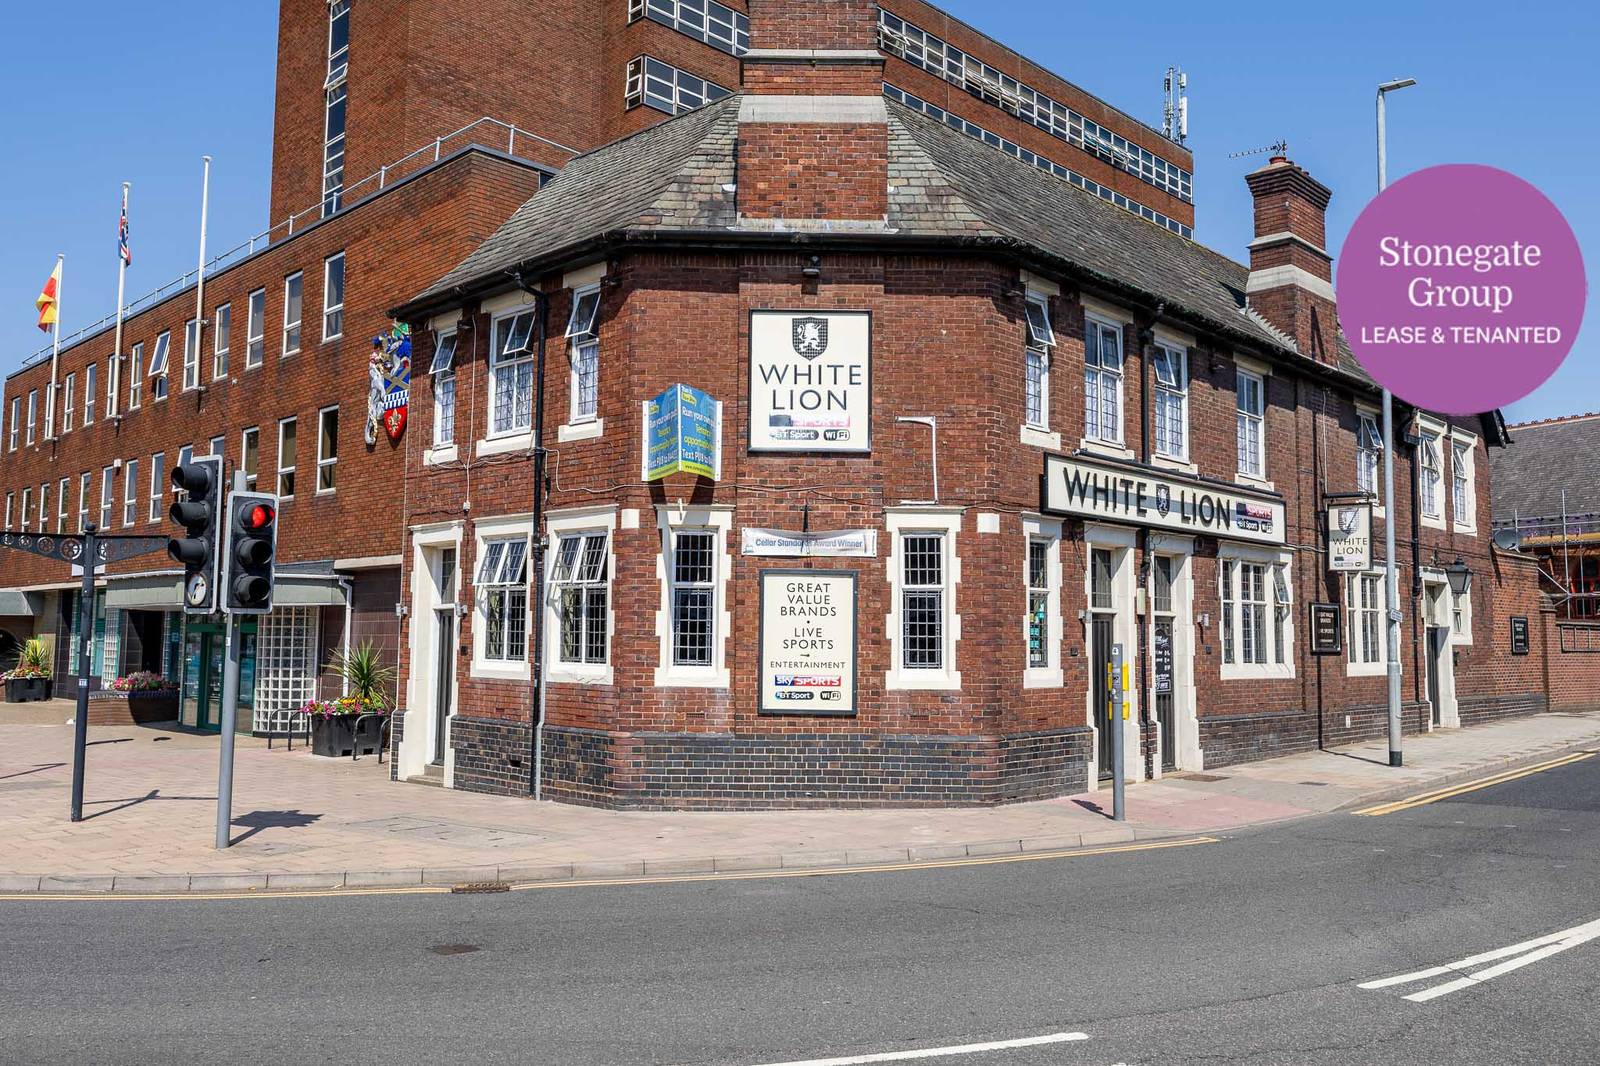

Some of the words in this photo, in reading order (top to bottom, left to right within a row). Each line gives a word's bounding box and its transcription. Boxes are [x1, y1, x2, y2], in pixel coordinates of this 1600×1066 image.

[758, 364, 862, 385] WHITE
[772, 389, 847, 411] LION
[790, 431, 815, 439] Sport
[1063, 467, 1147, 516] WHITE
[1180, 490, 1231, 529] LION
[755, 539, 776, 547] Cellar
[838, 540, 862, 548] Winner
[1332, 537, 1368, 545] WHITE
[1336, 546, 1363, 554] LION
[786, 582, 831, 593] GREAT
[787, 594, 831, 605] VALUE
[780, 606, 837, 616] BRANDS
[794, 627, 823, 638] LIVE
[783, 639, 834, 650] SPORTS
[770, 661, 847, 669] ENTERTAINMENT
[795, 676, 840, 686] SPORTS
[791, 692, 810, 700] Sport
